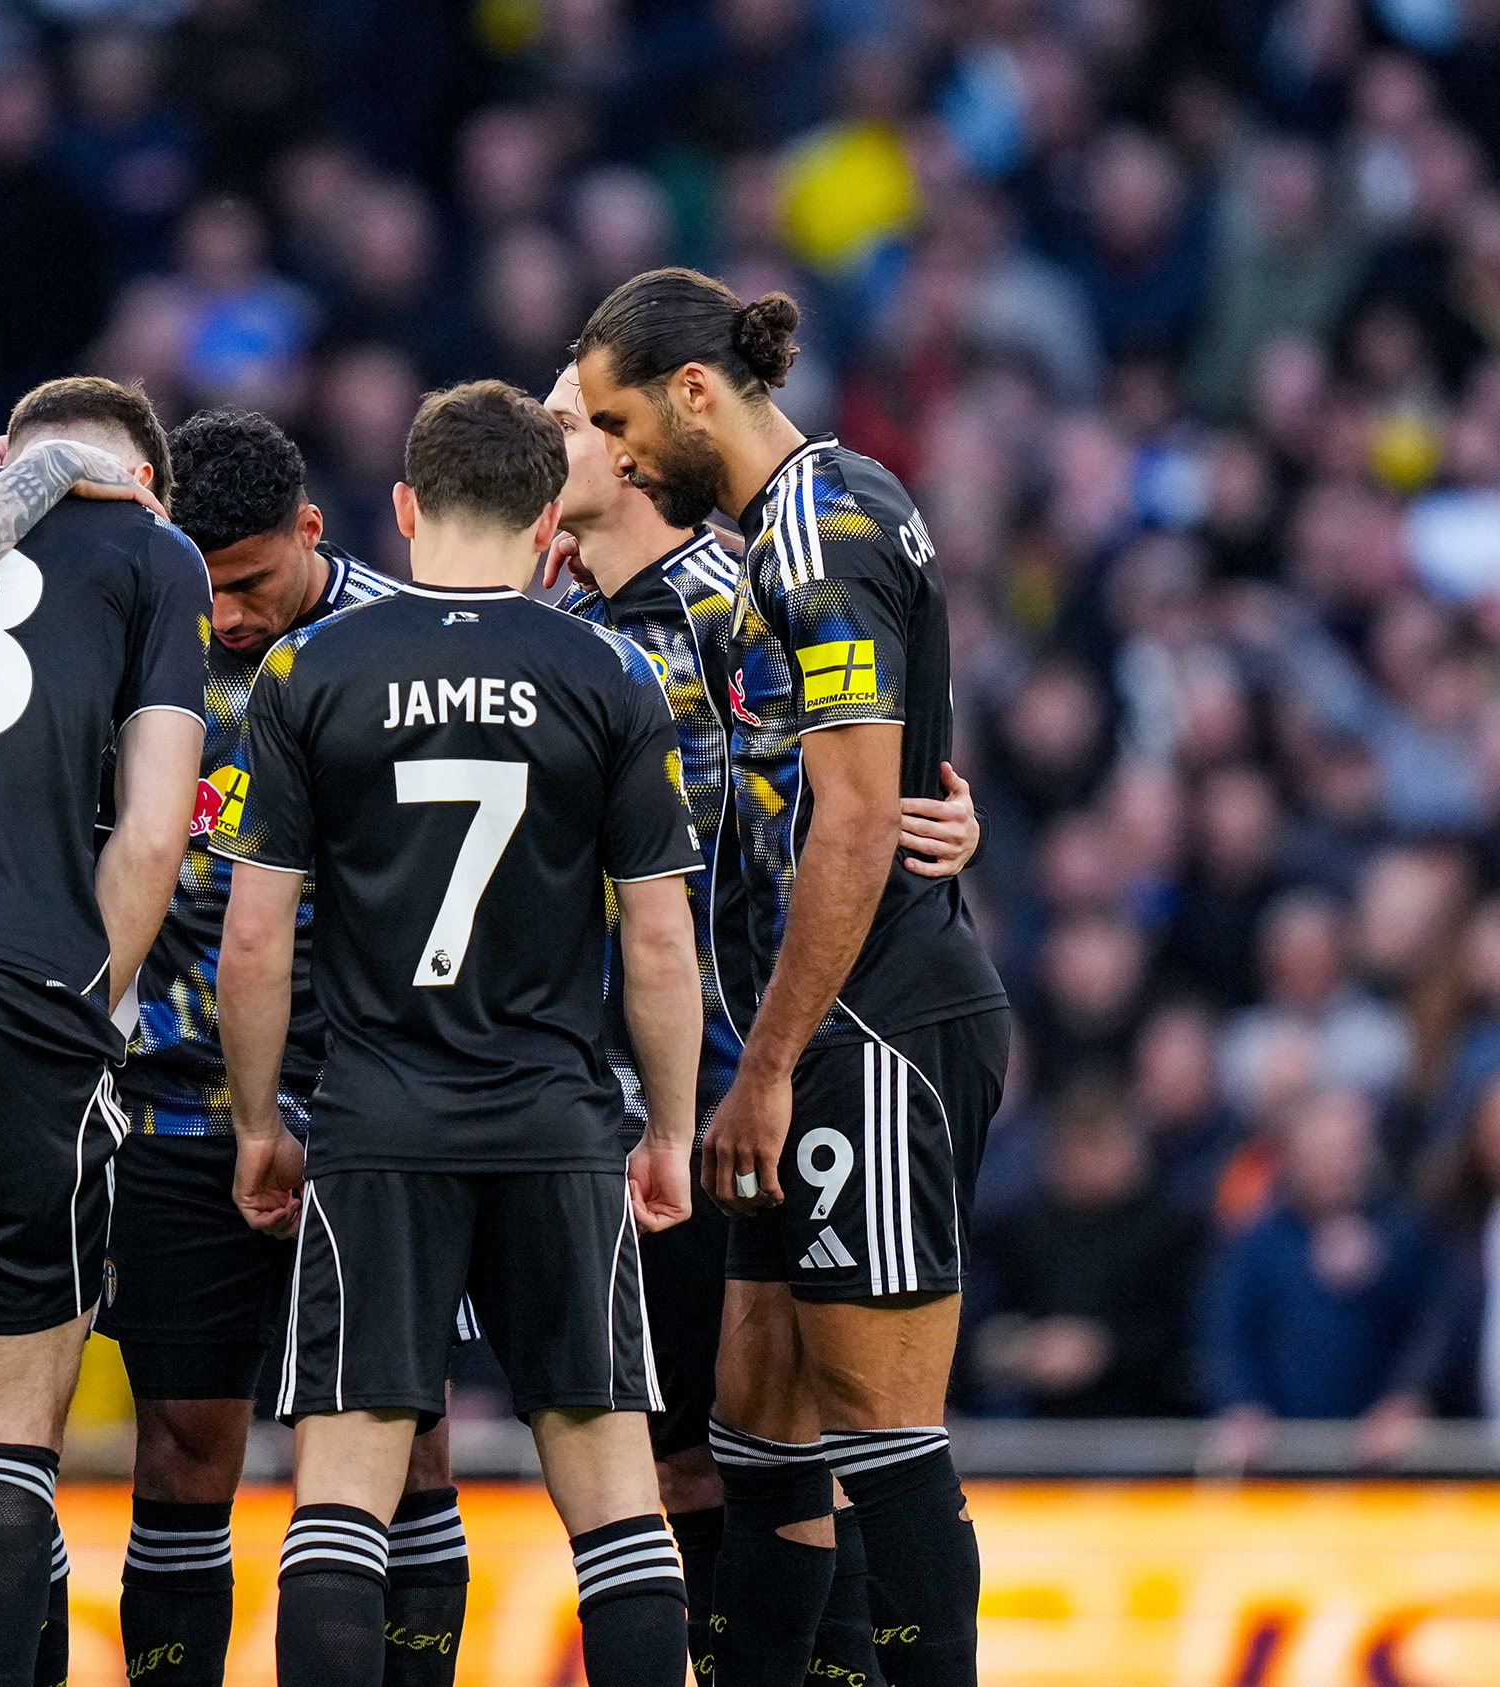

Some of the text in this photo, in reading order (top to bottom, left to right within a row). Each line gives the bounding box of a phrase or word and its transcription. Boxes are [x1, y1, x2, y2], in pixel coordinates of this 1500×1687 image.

[383, 677, 538, 729] JAMES
[806, 692, 875, 709] PARIMATCH
[394, 759, 529, 986] 7
[796, 1127, 855, 1220] 9
[126, 1642, 185, 1679] UFC
